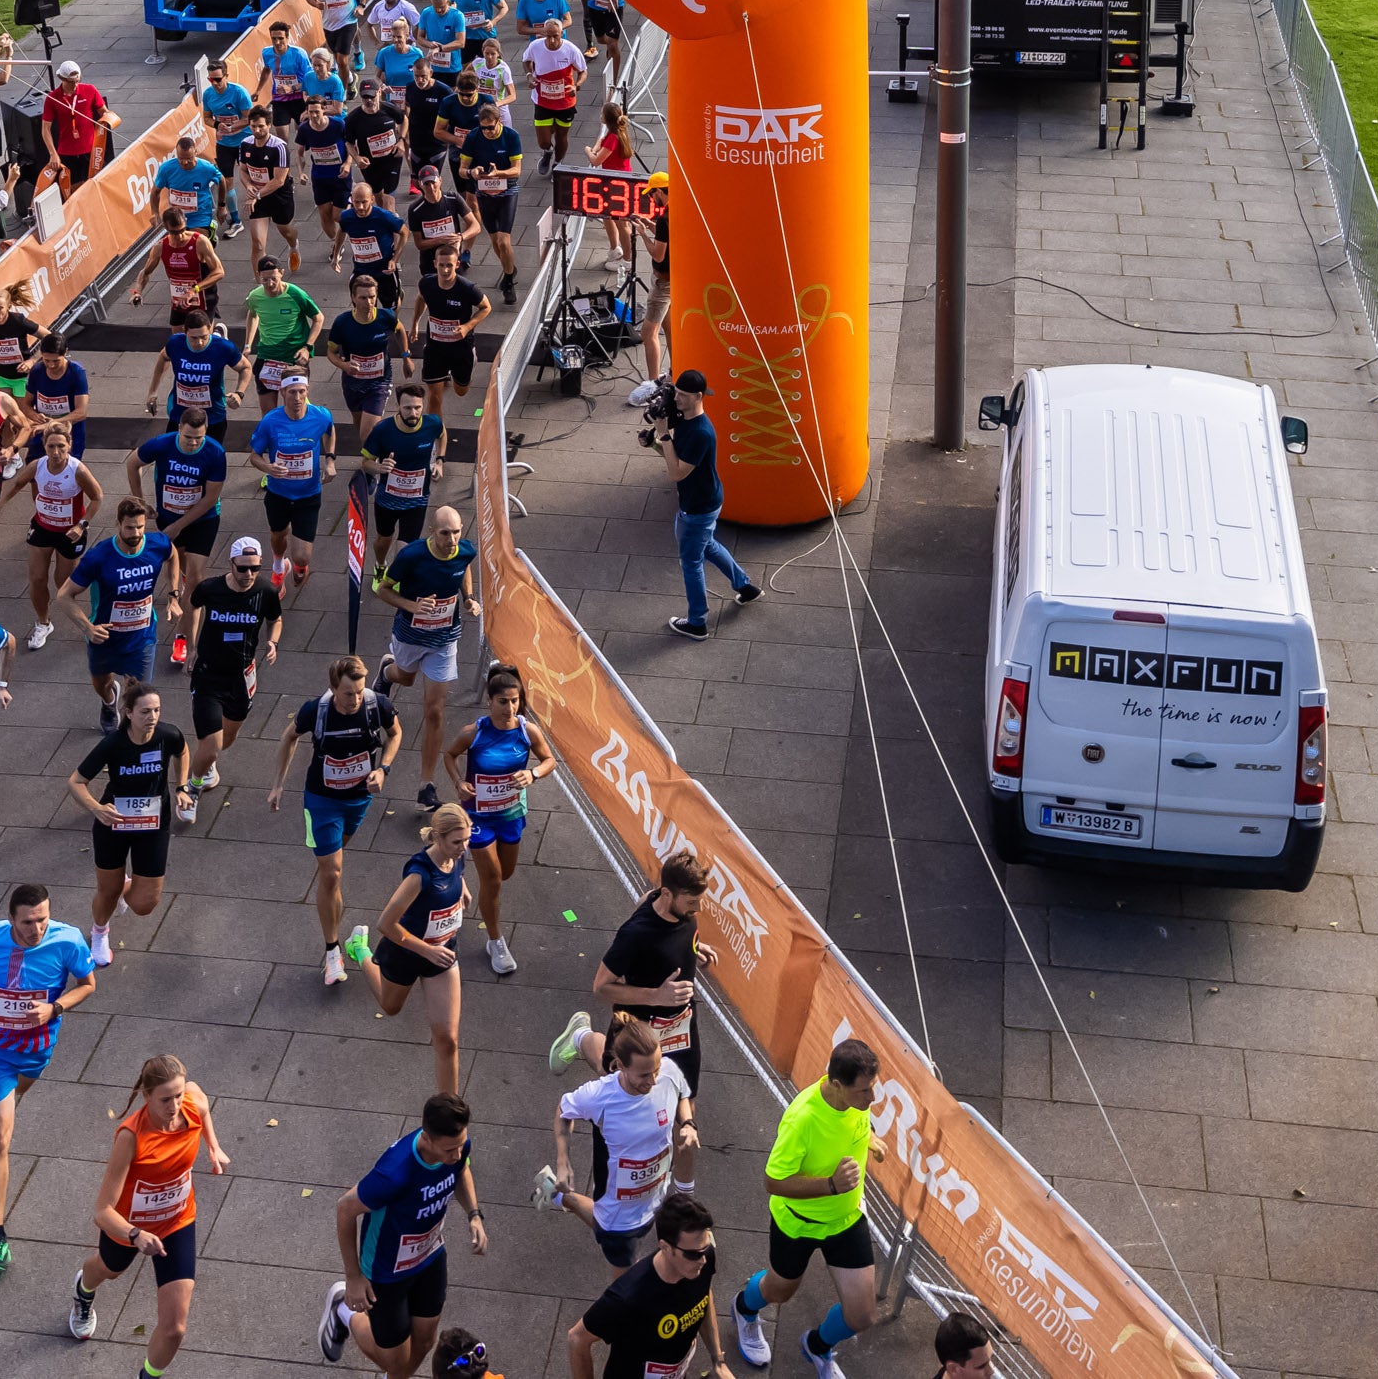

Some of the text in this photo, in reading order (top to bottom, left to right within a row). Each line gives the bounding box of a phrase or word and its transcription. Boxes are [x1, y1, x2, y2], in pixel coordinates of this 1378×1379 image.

[1025, 0, 1129, 9] LED-TRAILER-VERMITUNG
[1050, 54, 1065, 62] 220
[715, 103, 824, 144] DAK
[715, 141, 825, 166] Gesundheit
[54, 217, 89, 268] DAK
[719, 321, 810, 336] GEMEINSAM. AKTIV
[180, 358, 212, 371] Team
[177, 372, 211, 384] RWE
[168, 460, 200, 475] Team
[283, 460, 305, 468] 7135
[165, 473, 198, 485] RWE
[395, 477, 417, 485] 6532
[43, 503, 64, 513] 2661
[116, 563, 154, 581] Team
[117, 578, 154, 595] RWE
[210, 609, 259, 624] Deloitte.
[1056, 650, 1276, 691] MAXFUN
[1122, 698, 1153, 718] the
[1159, 702, 1200, 723] time
[1207, 707, 1223, 724] is
[1086, 748, 1101, 759] FIAT
[119, 762, 164, 777] Deloitte.
[330, 763, 364, 776] 17373
[125, 798, 152, 810] 1854
[1055, 811, 1134, 832] W 13982 B
[704, 853, 770, 959] DAK
[629, 1163, 661, 1182] 8330
[420, 1173, 456, 1202] Team
[142, 1187, 184, 1205] 14257
